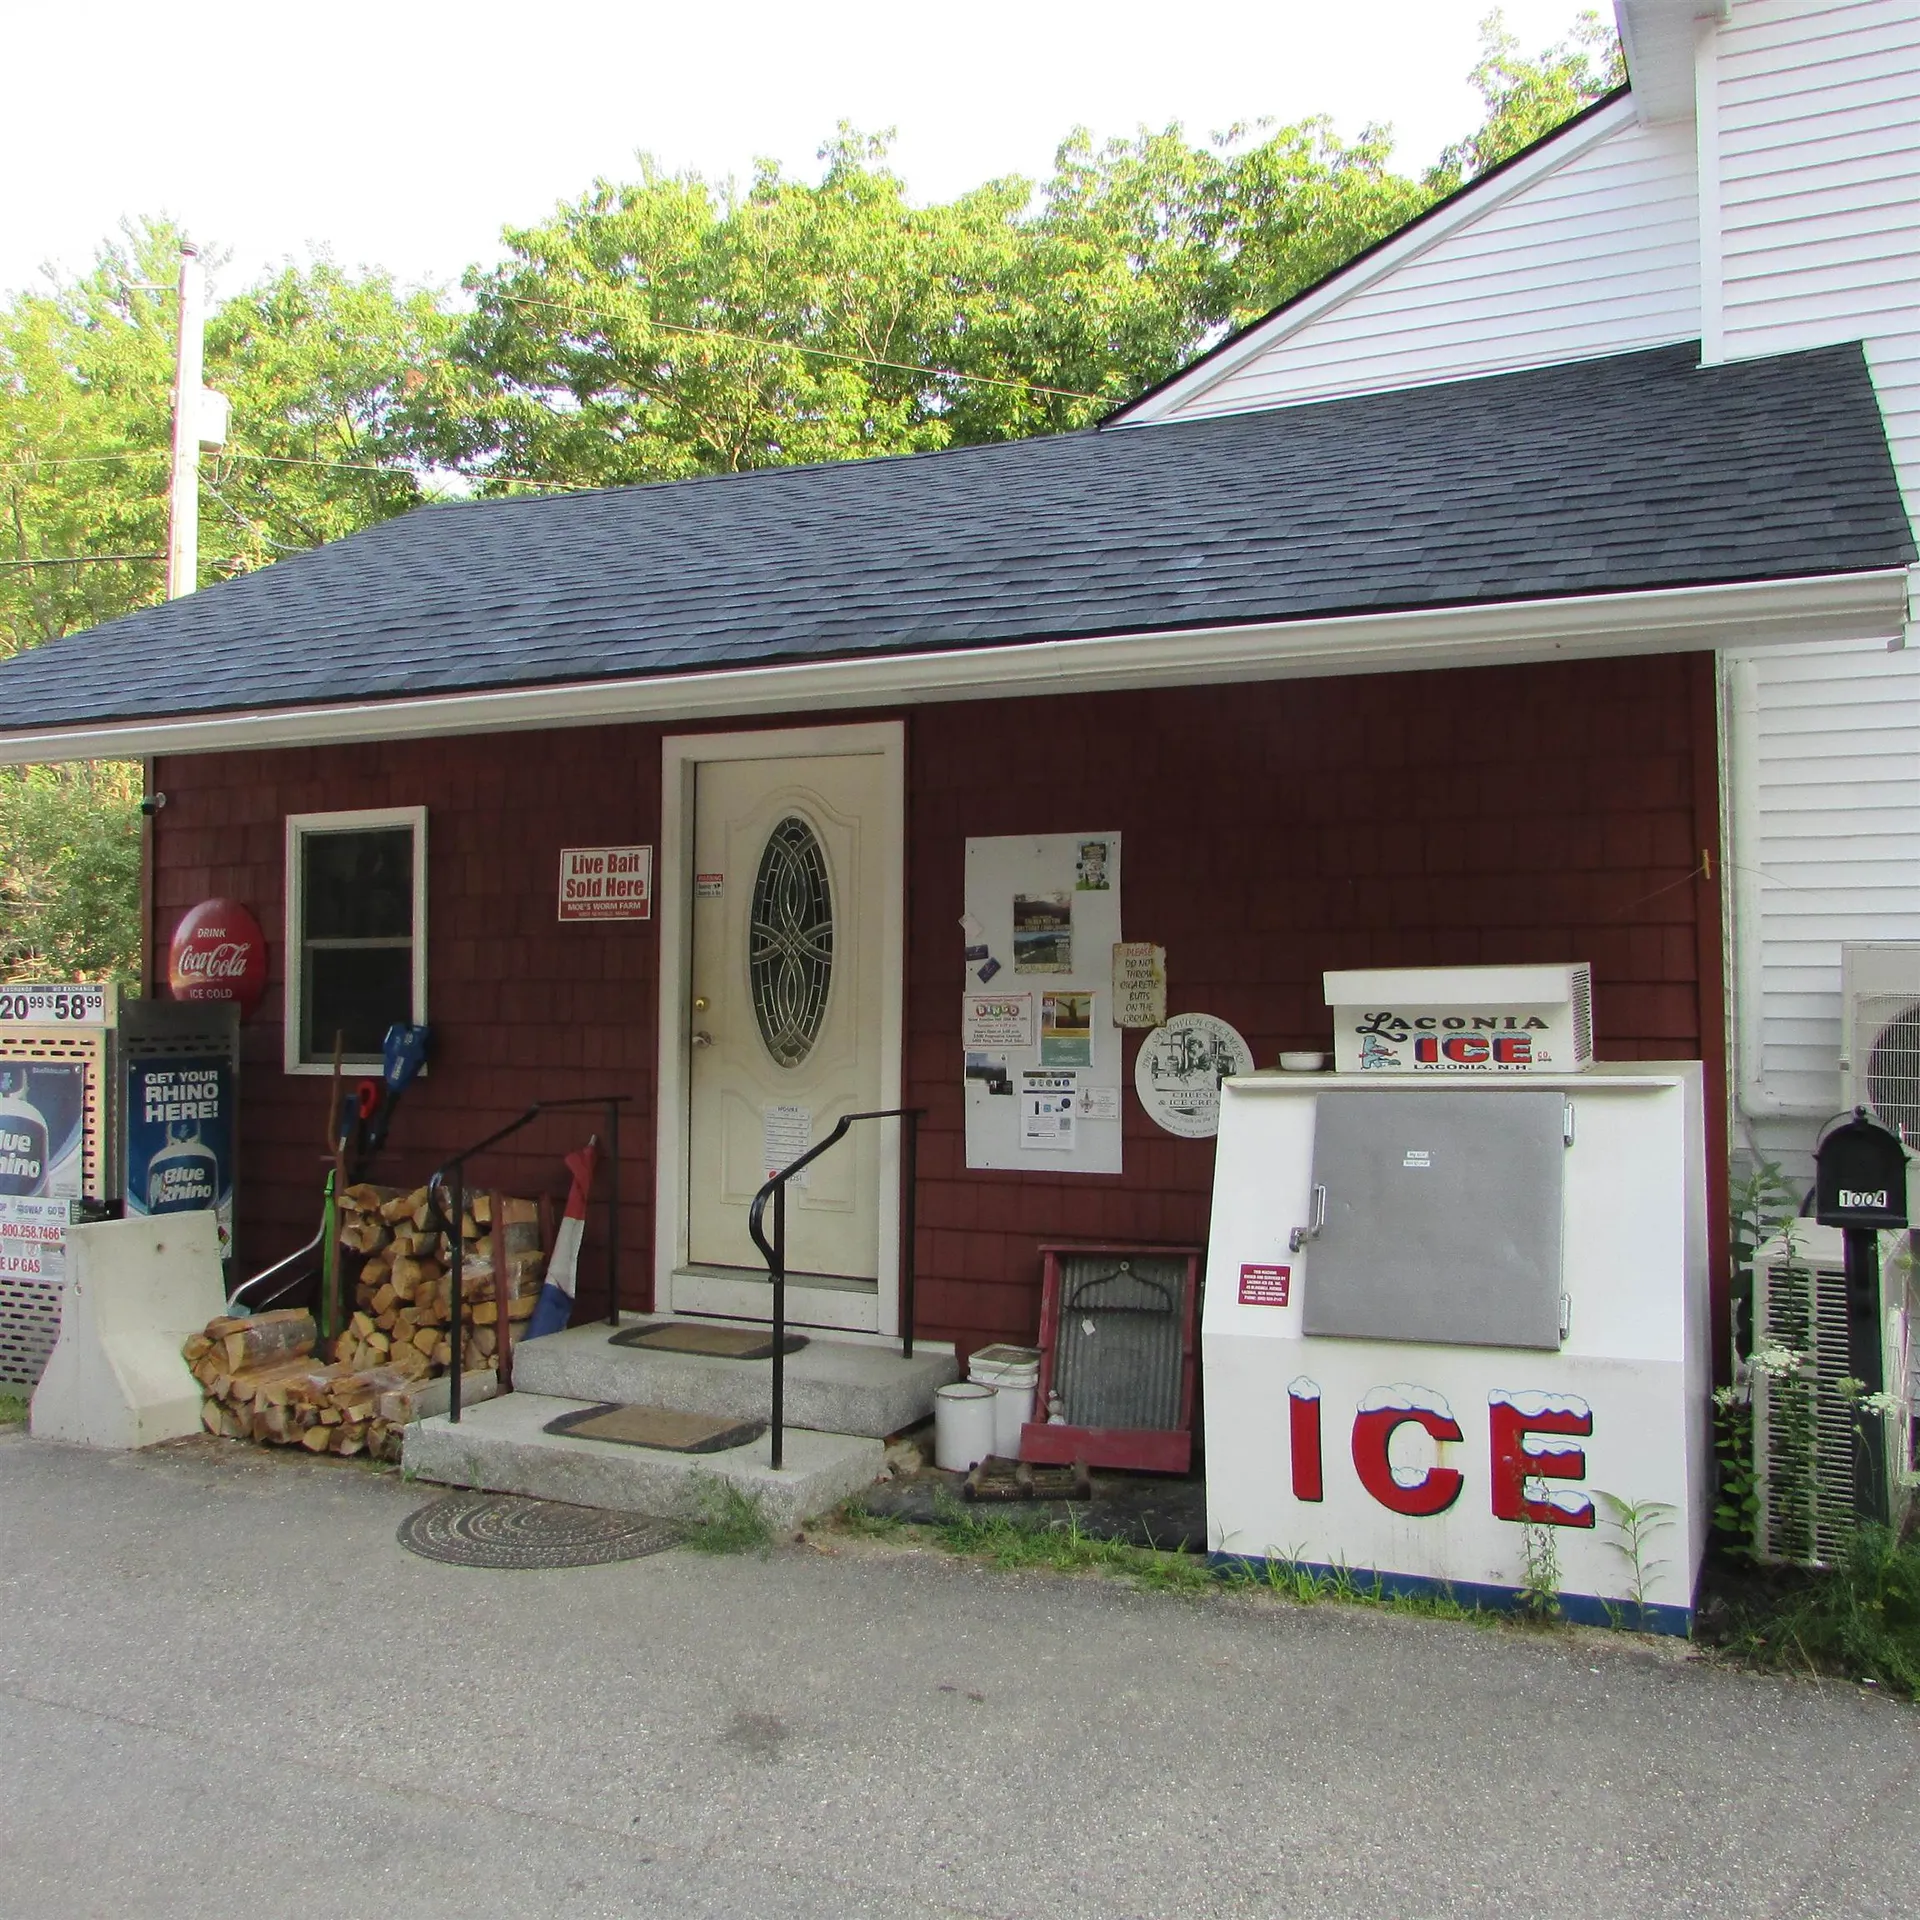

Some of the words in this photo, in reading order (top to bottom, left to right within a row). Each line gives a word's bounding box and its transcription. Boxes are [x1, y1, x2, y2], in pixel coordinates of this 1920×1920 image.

[572, 855, 604, 874] Live
[607, 853, 640, 873] Bait
[566, 878, 602, 898] Sold
[606, 877, 644, 897] Here
[567, 903, 591, 911] MOE'S
[593, 902, 617, 910] WORM
[620, 902, 641, 910] FARM
[198, 928, 226, 938] DRINK
[1125, 959, 1137, 968] DO
[1139, 959, 1153, 967] NOT
[1127, 970, 1153, 978] THROW
[190, 989, 204, 999] ICE
[206, 989, 233, 999] COLD
[1126, 1003, 1138, 1012] ON
[1140, 1003, 1153, 1011] THE
[1123, 1014, 1156, 1023] GROUND
[1356, 1012, 1549, 1042] LACONIA
[1413, 1032, 1532, 1063] ICE
[145, 1072, 175, 1085] GET
[180, 1070, 218, 1082] YOUR
[146, 1083, 219, 1102] RHINO
[146, 1101, 218, 1123] HERE!
[0, 1129, 31, 1152] lue
[165, 1167, 205, 1184] Blue
[1842, 1191, 1885, 1206] 1004
[8, 1257, 19, 1271] LP
[21, 1258, 40, 1273] GAS
[1287, 1376, 1595, 1529] ICE
